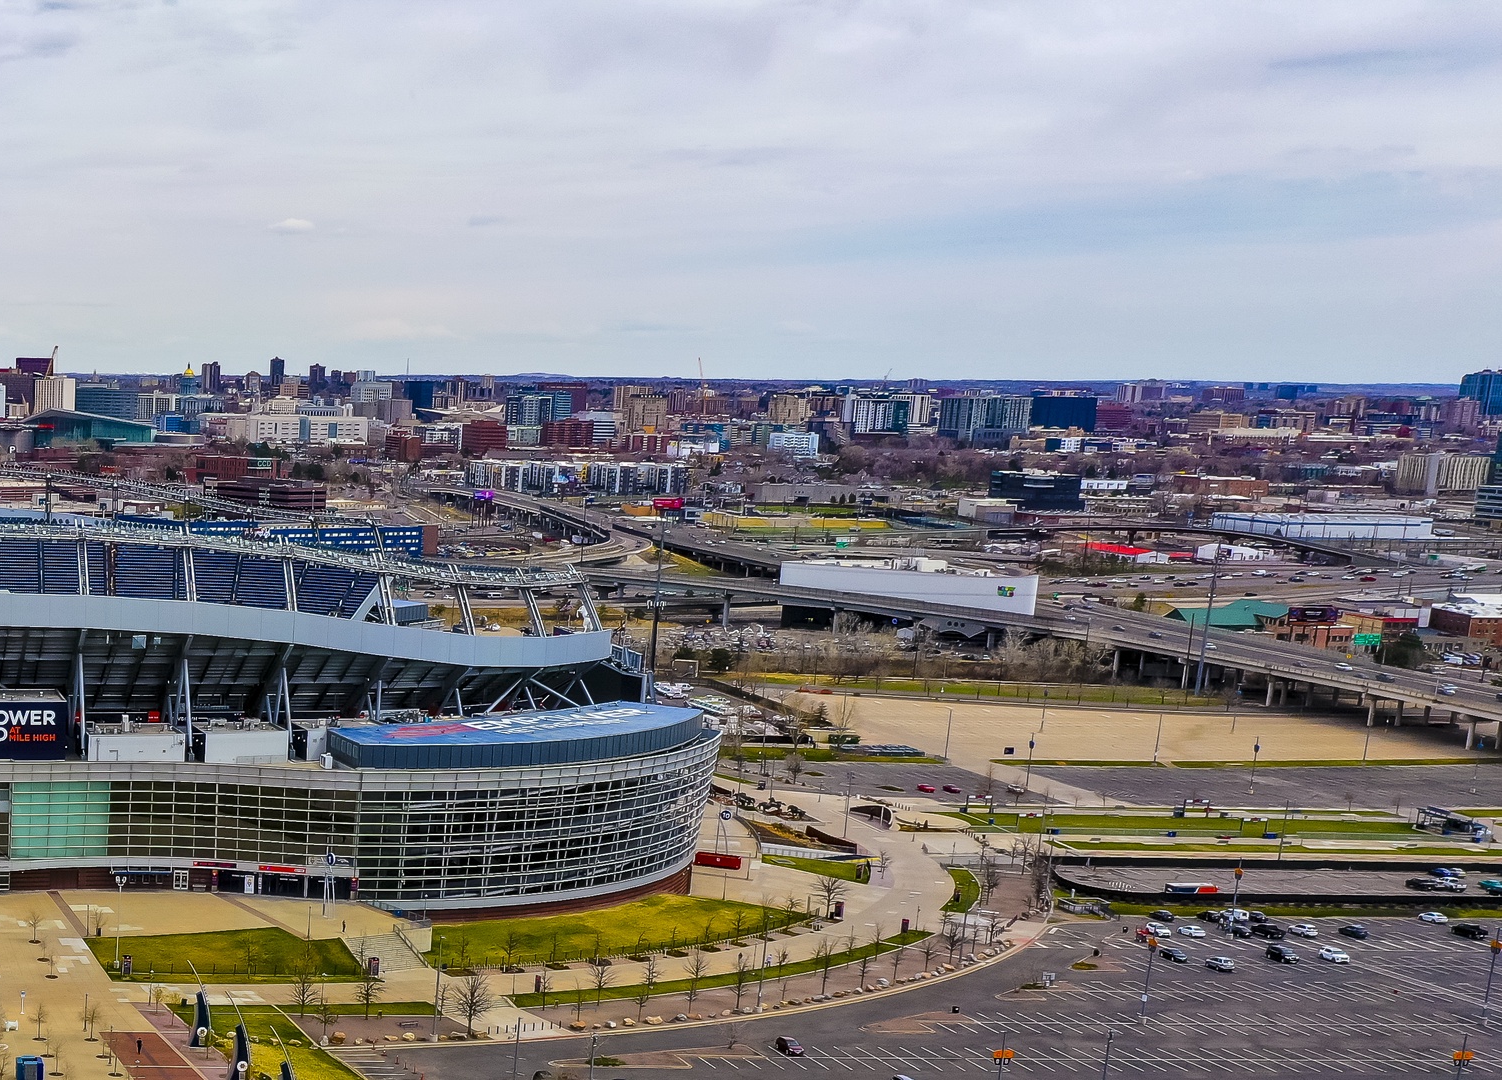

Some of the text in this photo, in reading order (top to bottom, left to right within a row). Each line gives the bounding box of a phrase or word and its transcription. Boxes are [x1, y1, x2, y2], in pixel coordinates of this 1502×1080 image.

[460, 707, 656, 731] EMPOWER
[9, 726, 21, 735] AT
[9, 734, 56, 742] MILE HIGH
